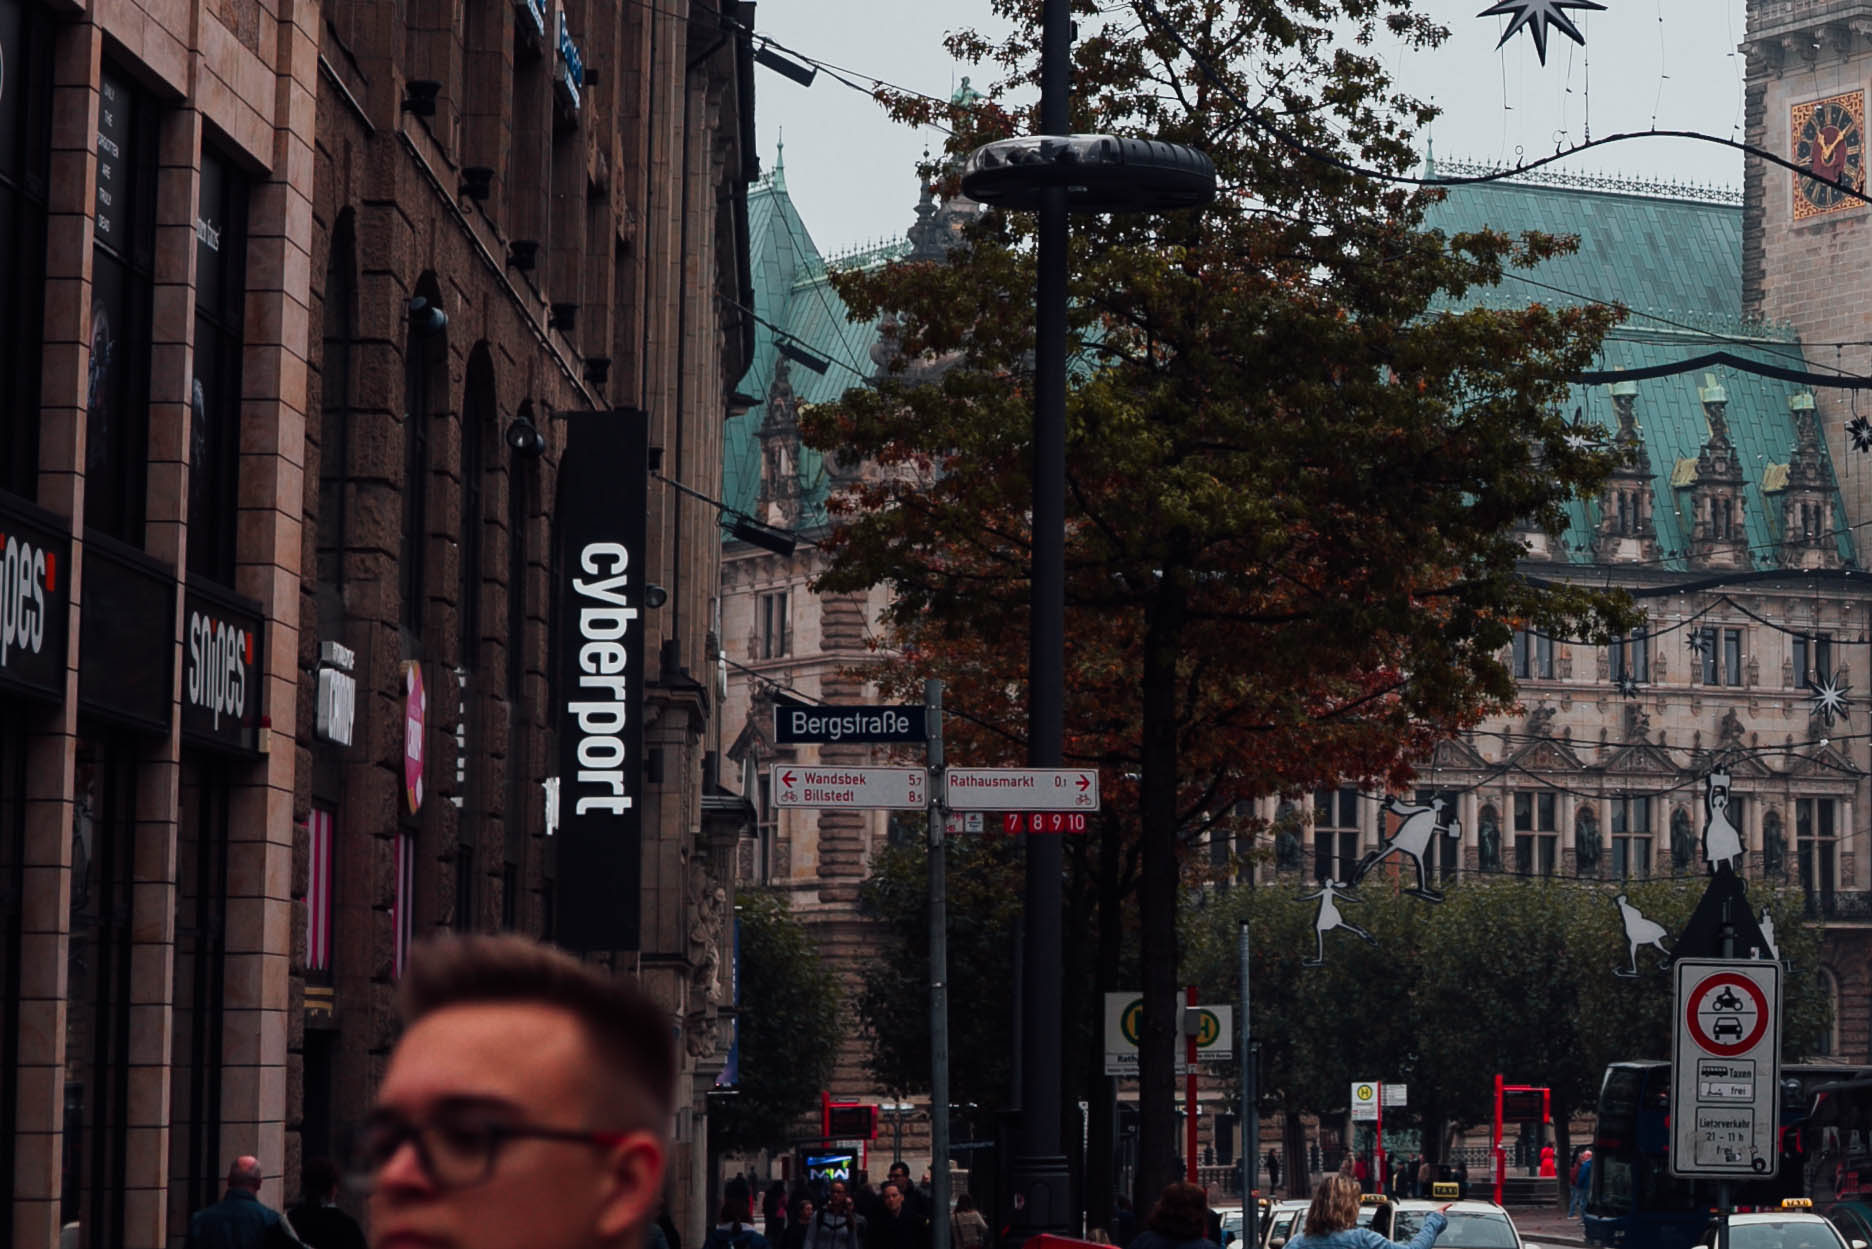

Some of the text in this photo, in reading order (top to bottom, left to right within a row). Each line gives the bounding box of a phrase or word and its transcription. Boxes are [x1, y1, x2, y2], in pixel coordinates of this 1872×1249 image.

[189, 610, 247, 732] snipes
[568, 542, 638, 816] cyberport
[791, 711, 910, 741] Bergstraße
[804, 772, 866, 785] Wandsbek
[950, 775, 1035, 788] Rathausmarkt
[803, 789, 854, 802] Billstedt
[1008, 813, 1085, 831] 7 8 9 10
[1729, 1068, 1752, 1079] Taxen
[1731, 1086, 1746, 1095] frei
[1699, 1118, 1751, 1129] Lieferverkehr
[1705, 1131, 1716, 1142] 21
[1727, 1131, 1736, 1141] 11
[1716, 1145, 1733, 1155] frei
[1435, 1185, 1458, 1195] TAXI
